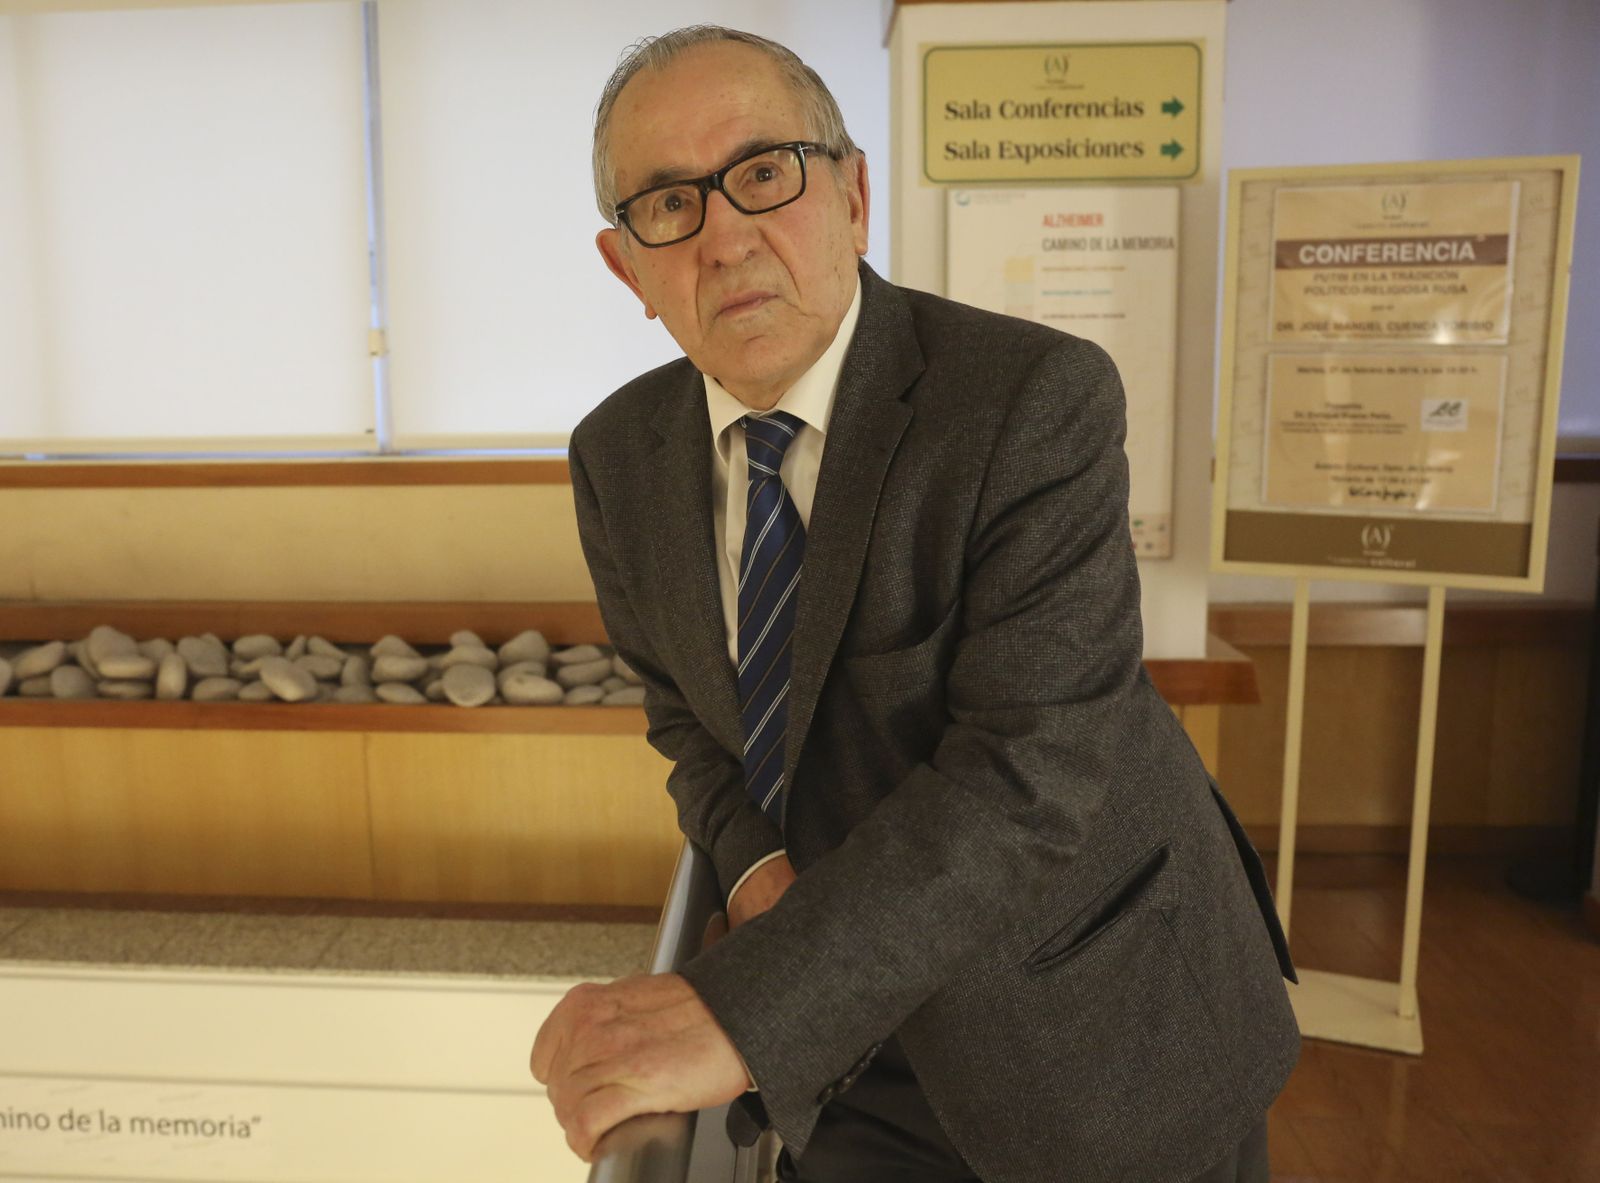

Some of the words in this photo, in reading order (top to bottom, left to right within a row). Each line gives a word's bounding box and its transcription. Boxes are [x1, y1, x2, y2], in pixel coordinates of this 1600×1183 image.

[944, 100, 991, 121] Sala
[999, 97, 1145, 120] Conferencias
[944, 140, 991, 161] Sala
[998, 137, 1145, 164] Exposiciones
[1042, 212, 1104, 227] ALZHEIMER
[1042, 237, 1087, 251] CAMINO
[1089, 238, 1103, 250] DE
[1106, 237, 1119, 250] LA
[1122, 236, 1176, 250] MEMORIA
[1298, 241, 1476, 265] CONFERENCIA
[0, 1107, 51, 1131] ino
[57, 1107, 92, 1133] de
[99, 1108, 122, 1134] la
